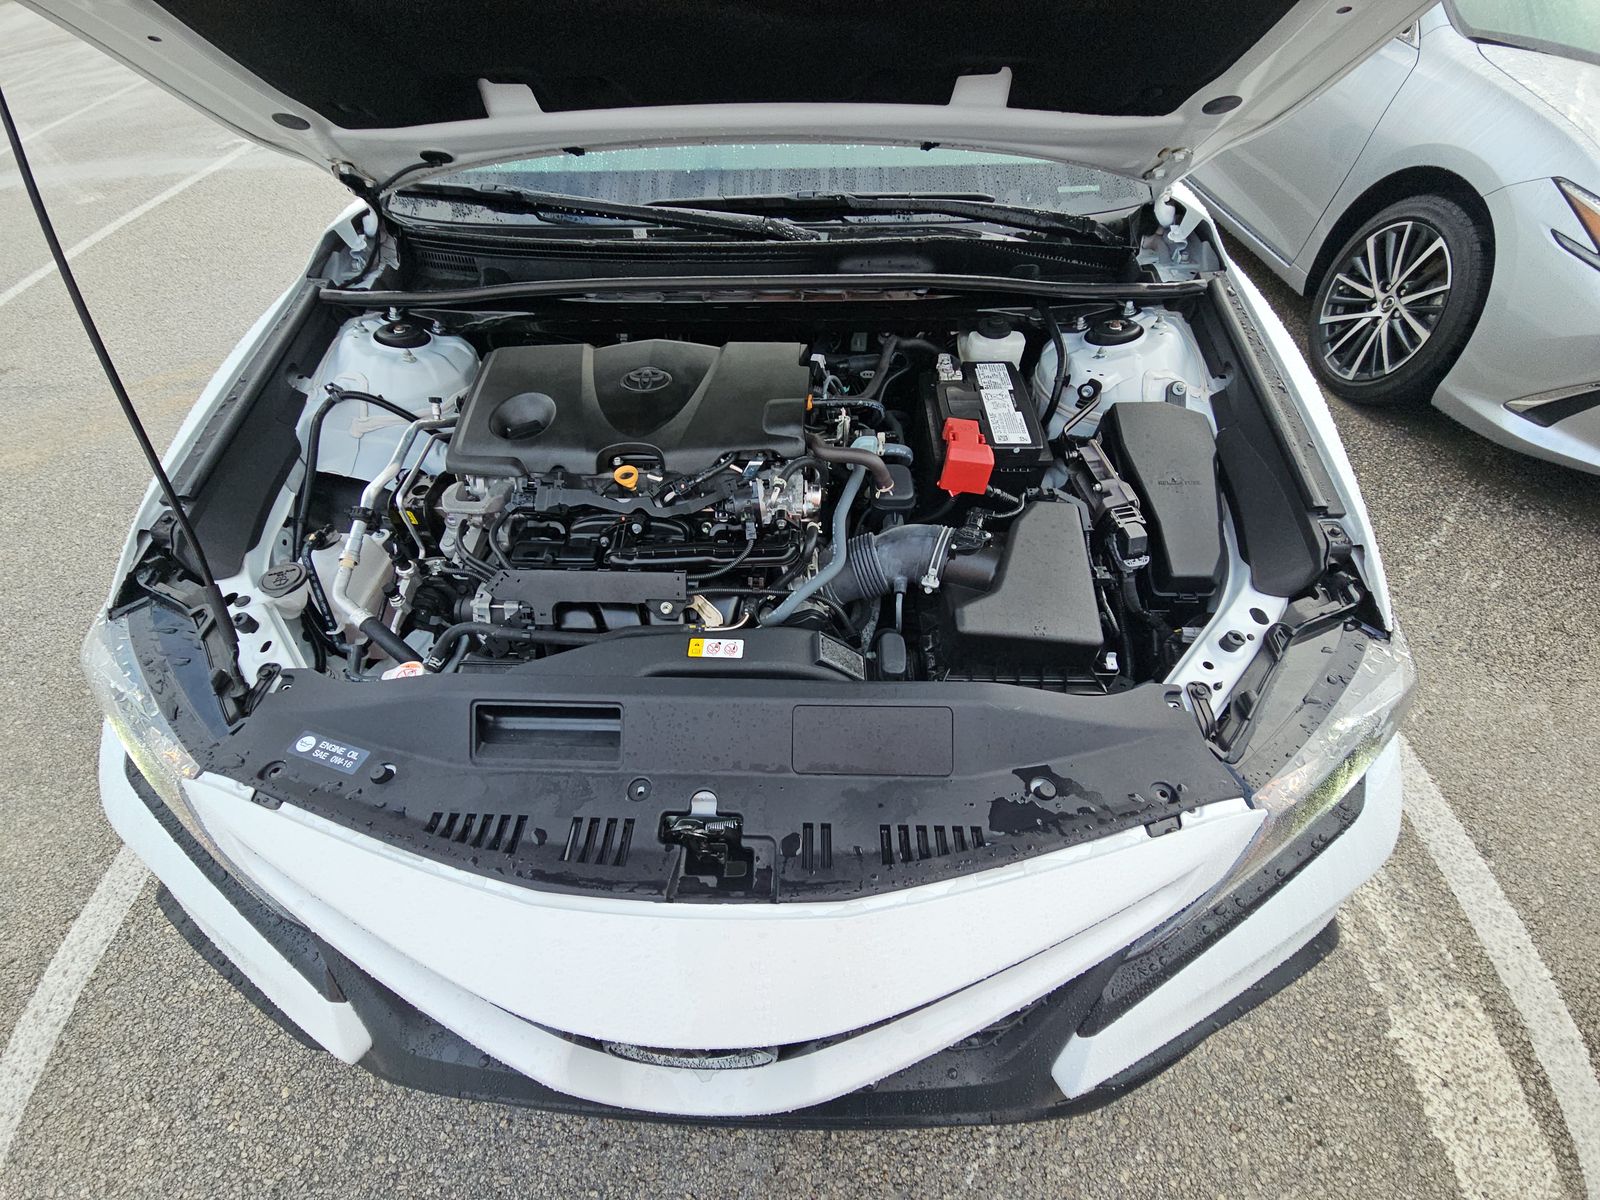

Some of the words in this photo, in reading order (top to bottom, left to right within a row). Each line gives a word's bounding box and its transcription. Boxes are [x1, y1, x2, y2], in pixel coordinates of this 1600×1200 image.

[312, 749, 330, 760] SAE
[330, 755, 353, 769] 0W-16
[319, 741, 346, 755] ENGINE
[347, 750, 359, 760] OIL
